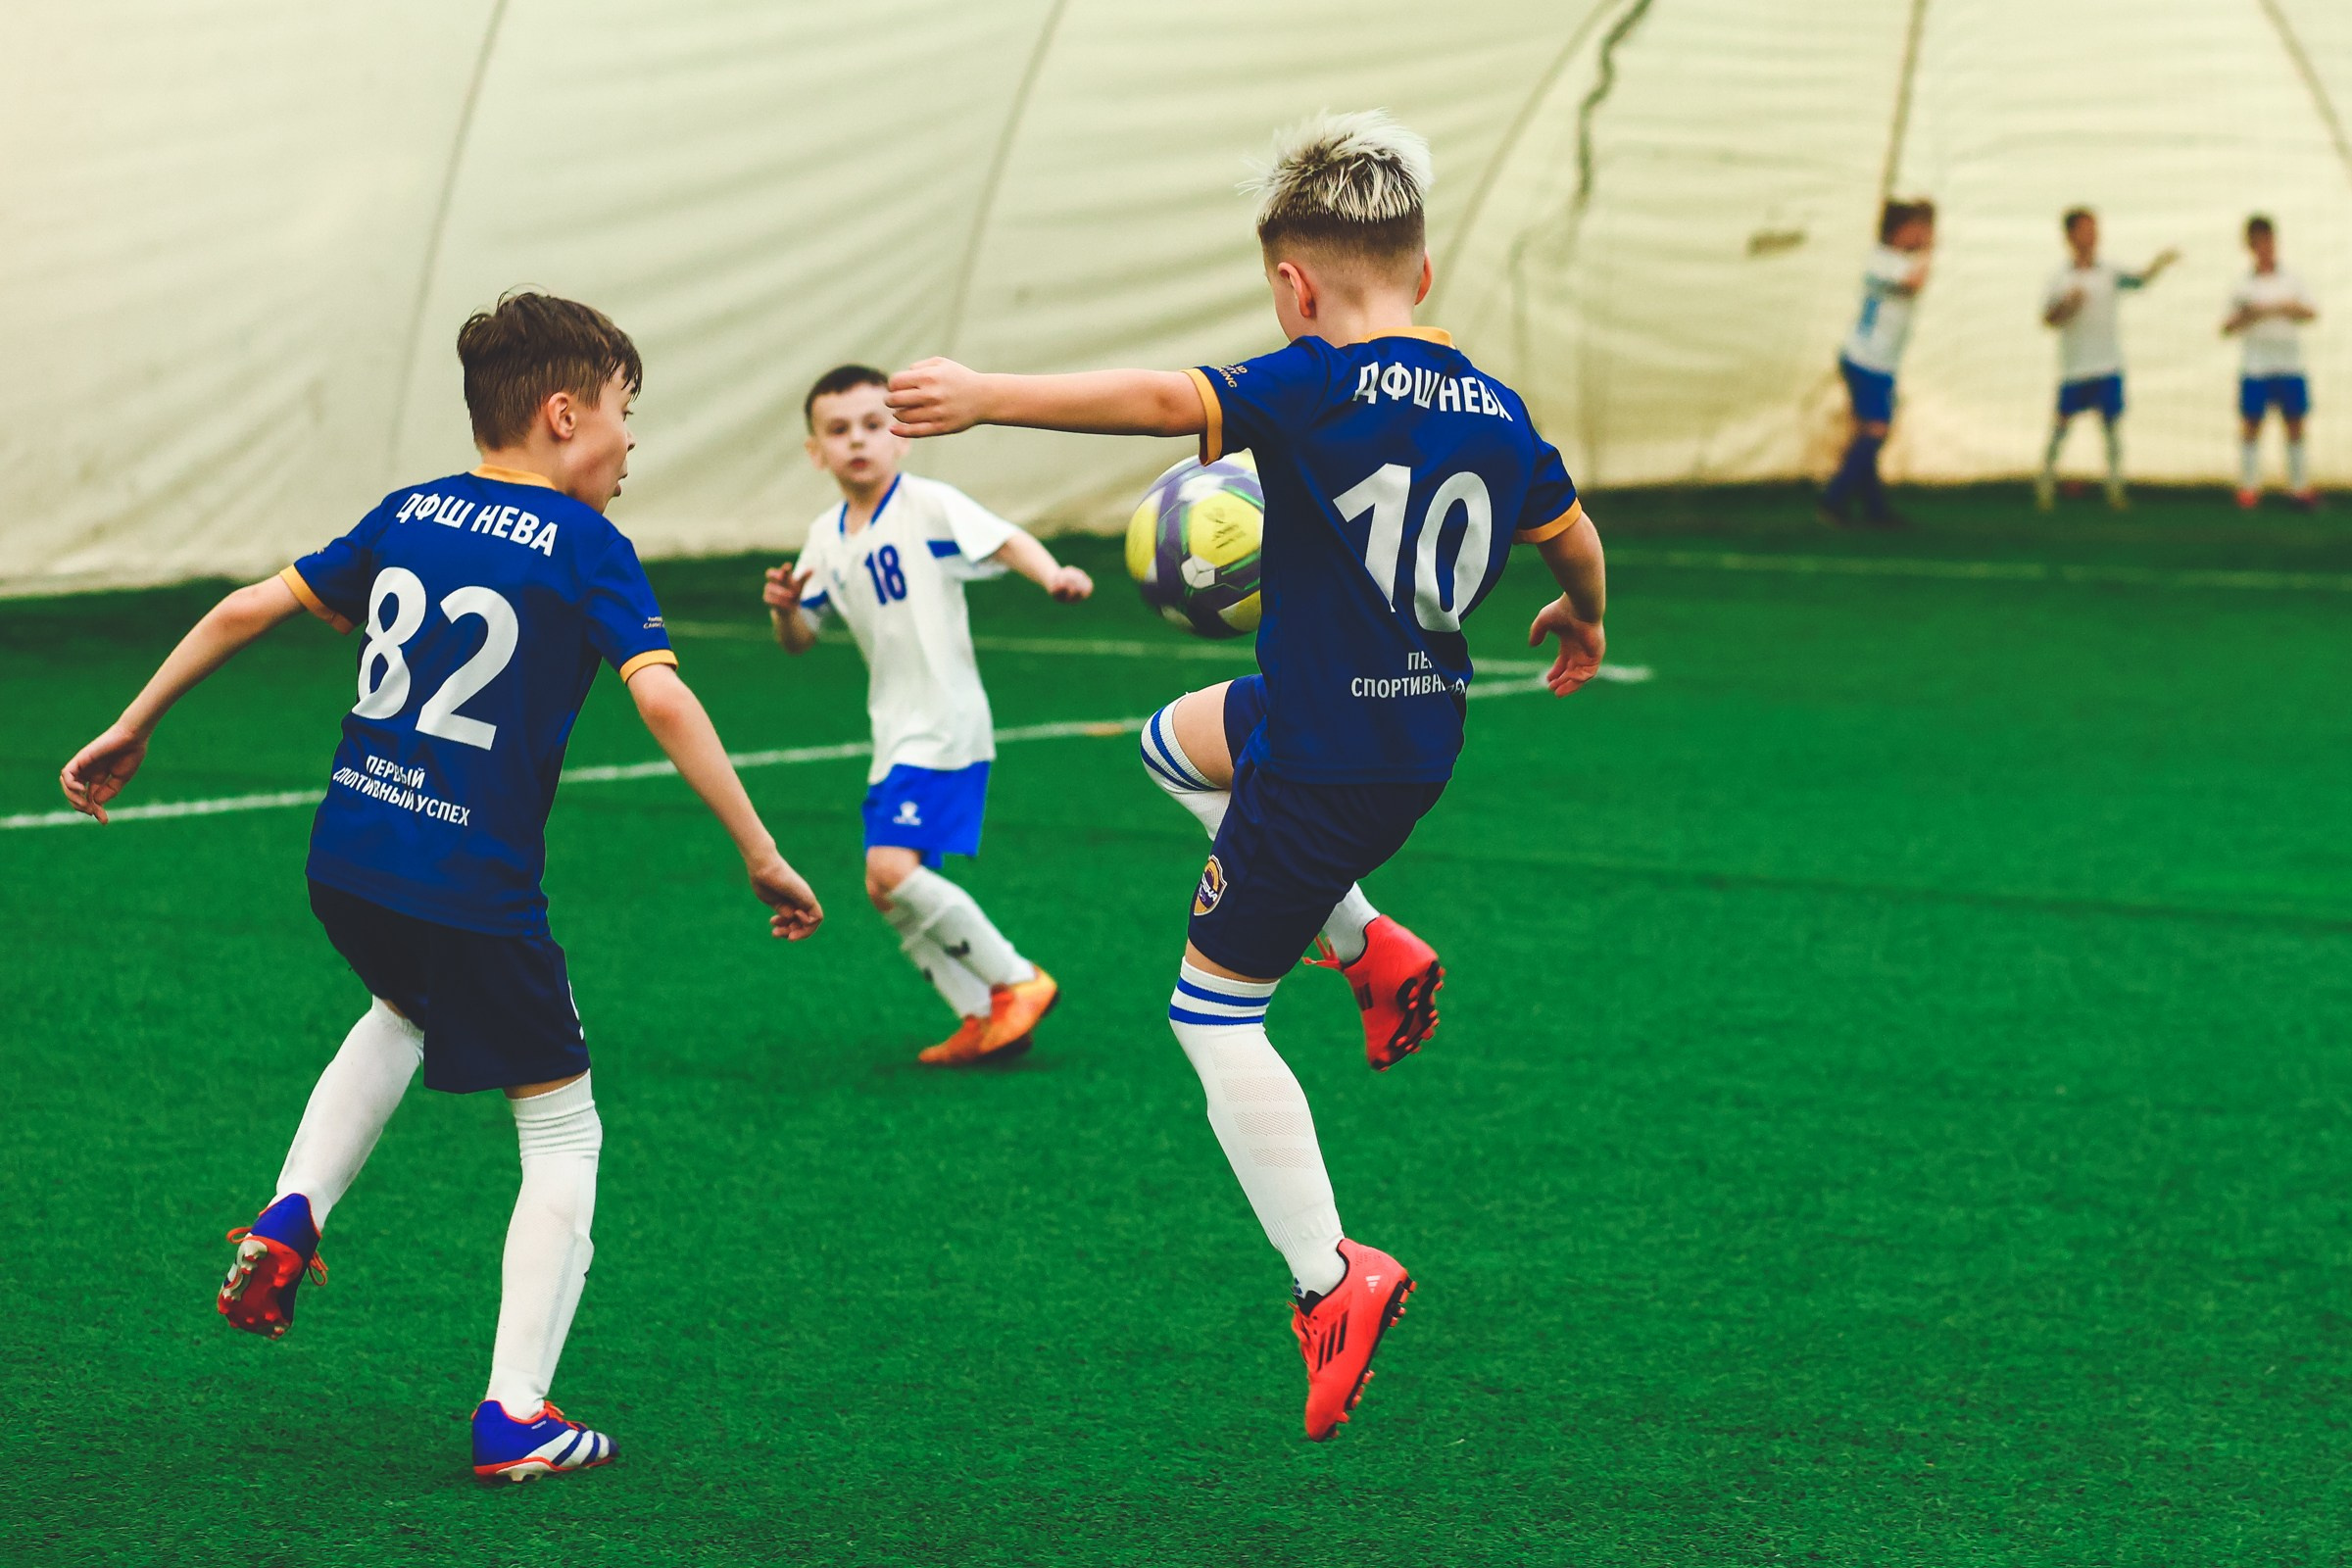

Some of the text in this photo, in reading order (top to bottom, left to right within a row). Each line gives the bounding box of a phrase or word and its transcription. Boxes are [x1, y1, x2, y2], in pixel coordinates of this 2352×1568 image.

[396, 492, 559, 557] ДФШ НЕВА
[1333, 463, 1493, 633] 10
[864, 544, 907, 605] 18
[351, 566, 519, 751] 82
[366, 754, 426, 789] ПЕРВЫЙ
[415, 794, 471, 827] УСПЕХ
